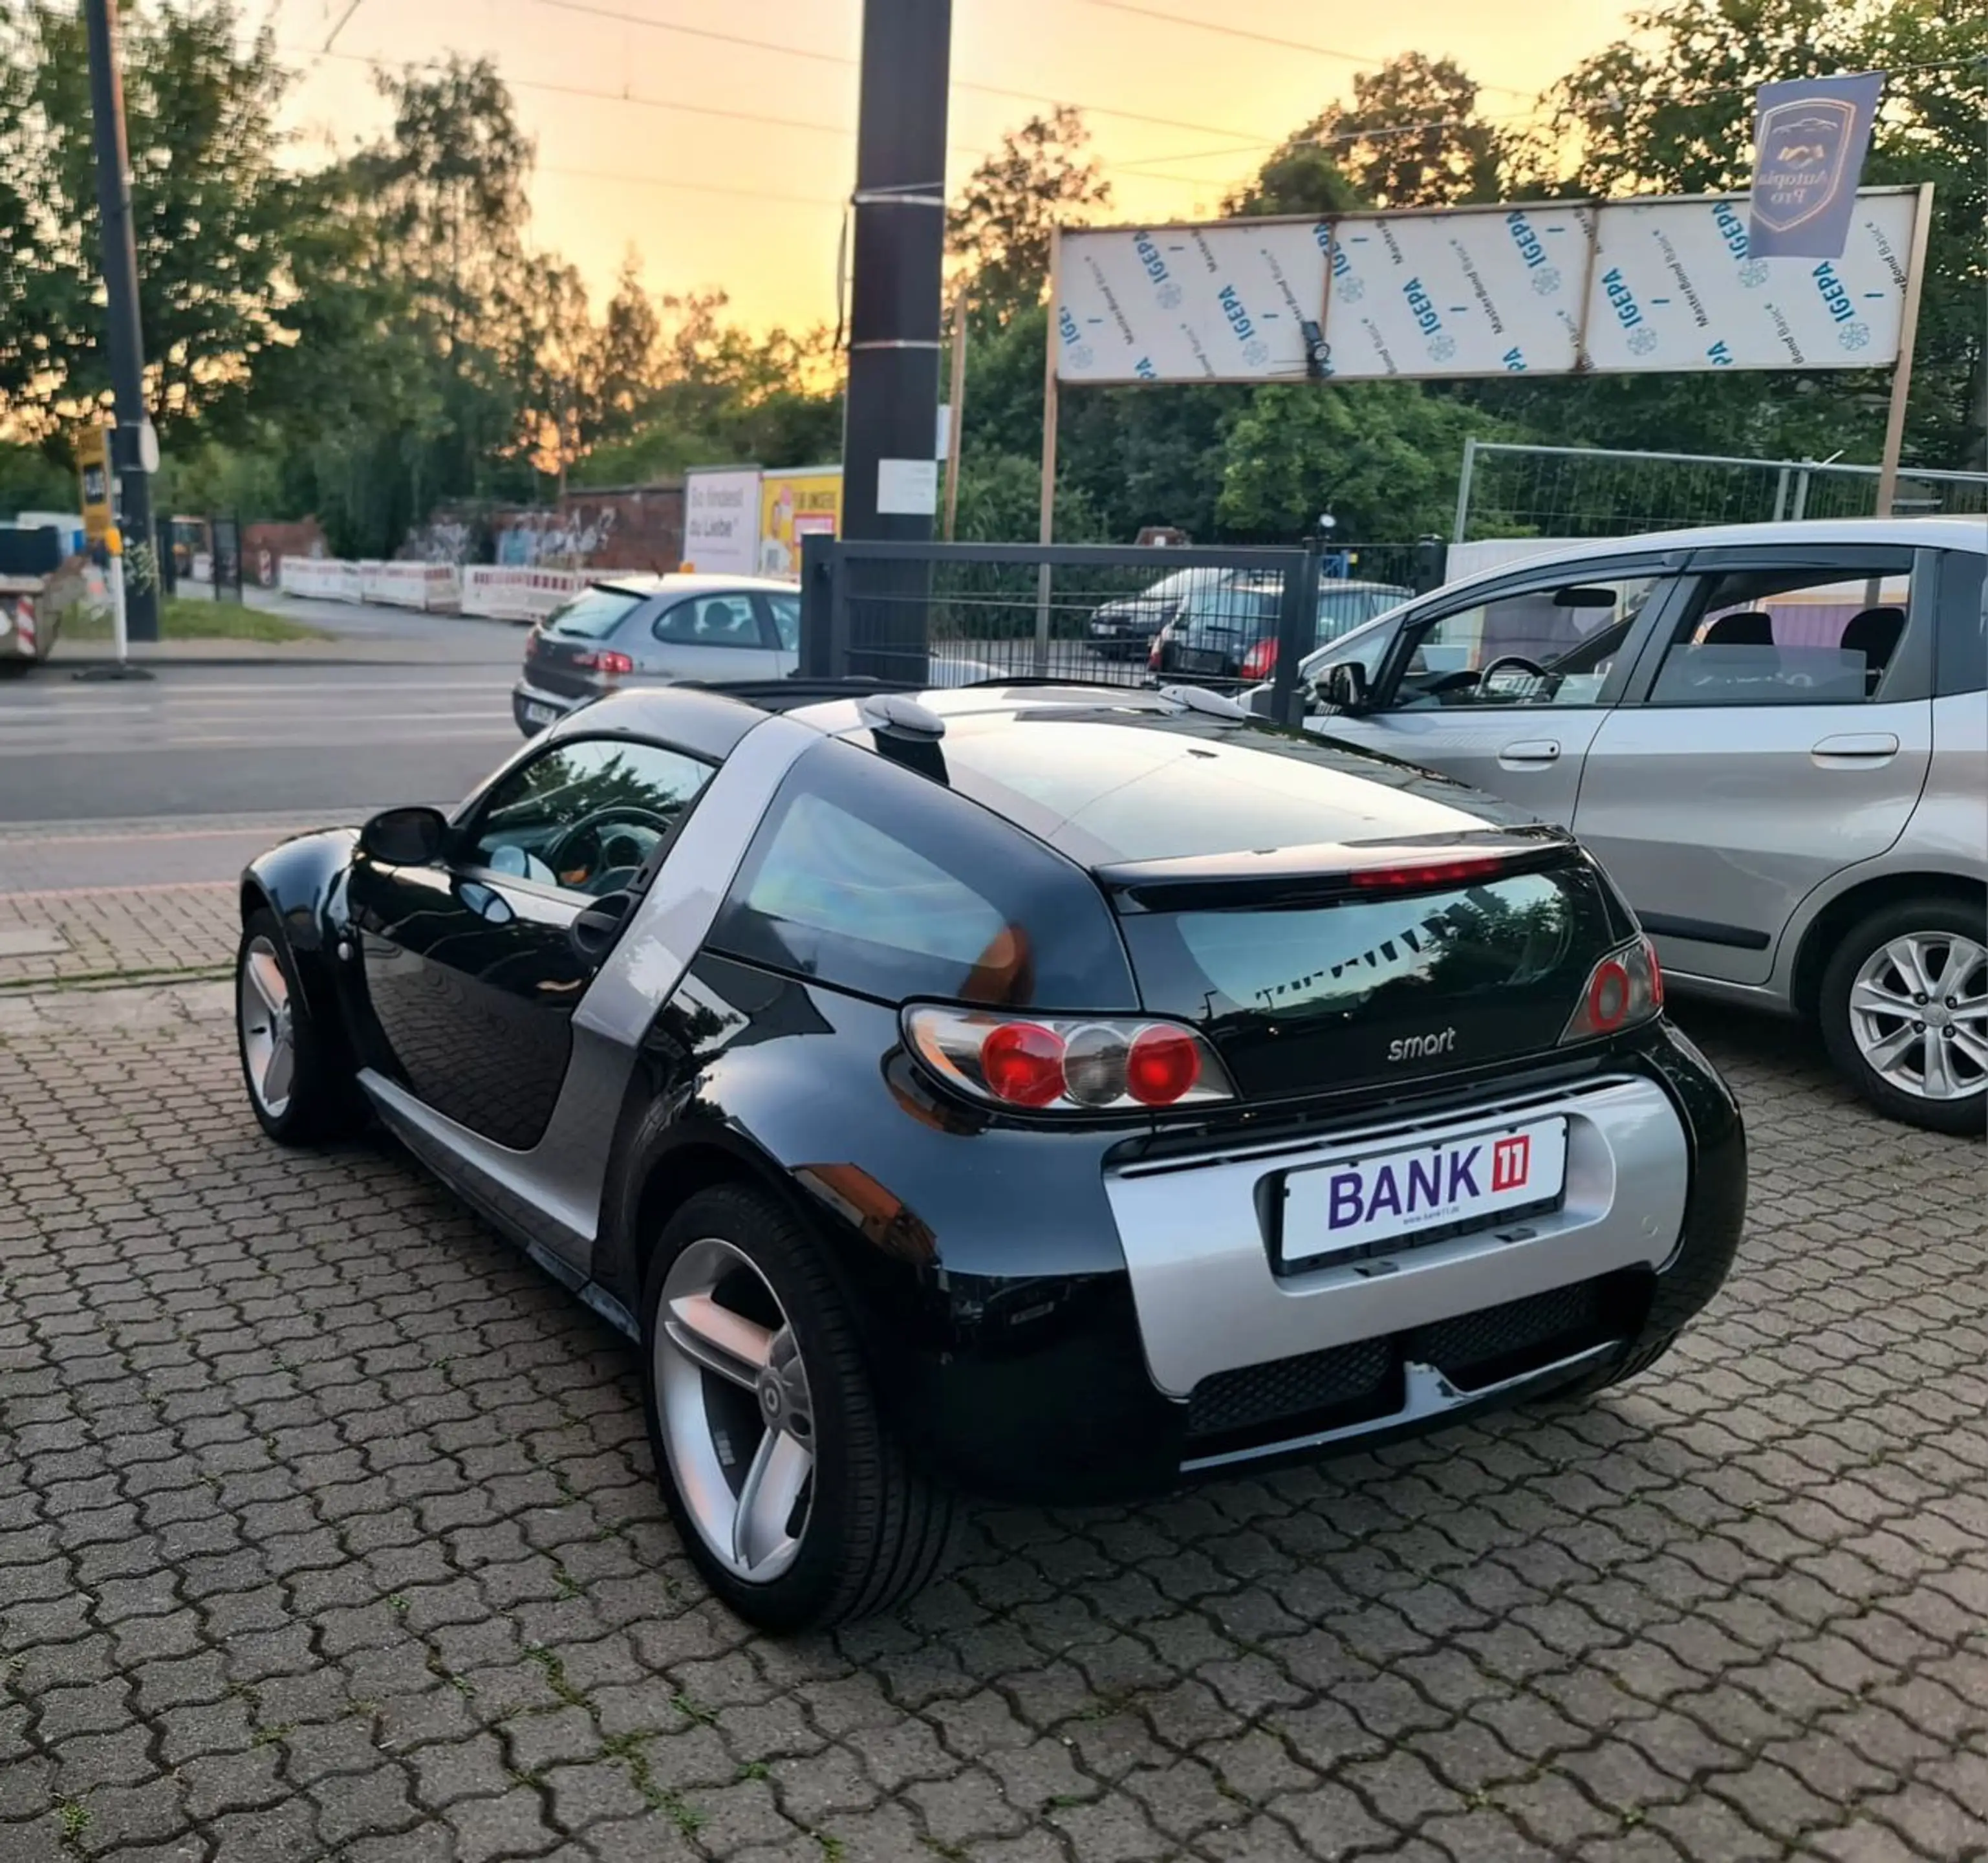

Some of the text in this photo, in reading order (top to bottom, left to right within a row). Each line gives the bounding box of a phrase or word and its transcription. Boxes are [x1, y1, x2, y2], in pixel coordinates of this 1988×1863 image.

[1505, 210, 1546, 268] IGEPA
[1218, 284, 1256, 341] IGEPA
[1403, 277, 1442, 335] IGEPA
[1602, 268, 1643, 329] IGEPA
[1813, 261, 1855, 323] IGEPA
[1387, 1027, 1456, 1061] smart
[1328, 1140, 1526, 1230] BANK 11
